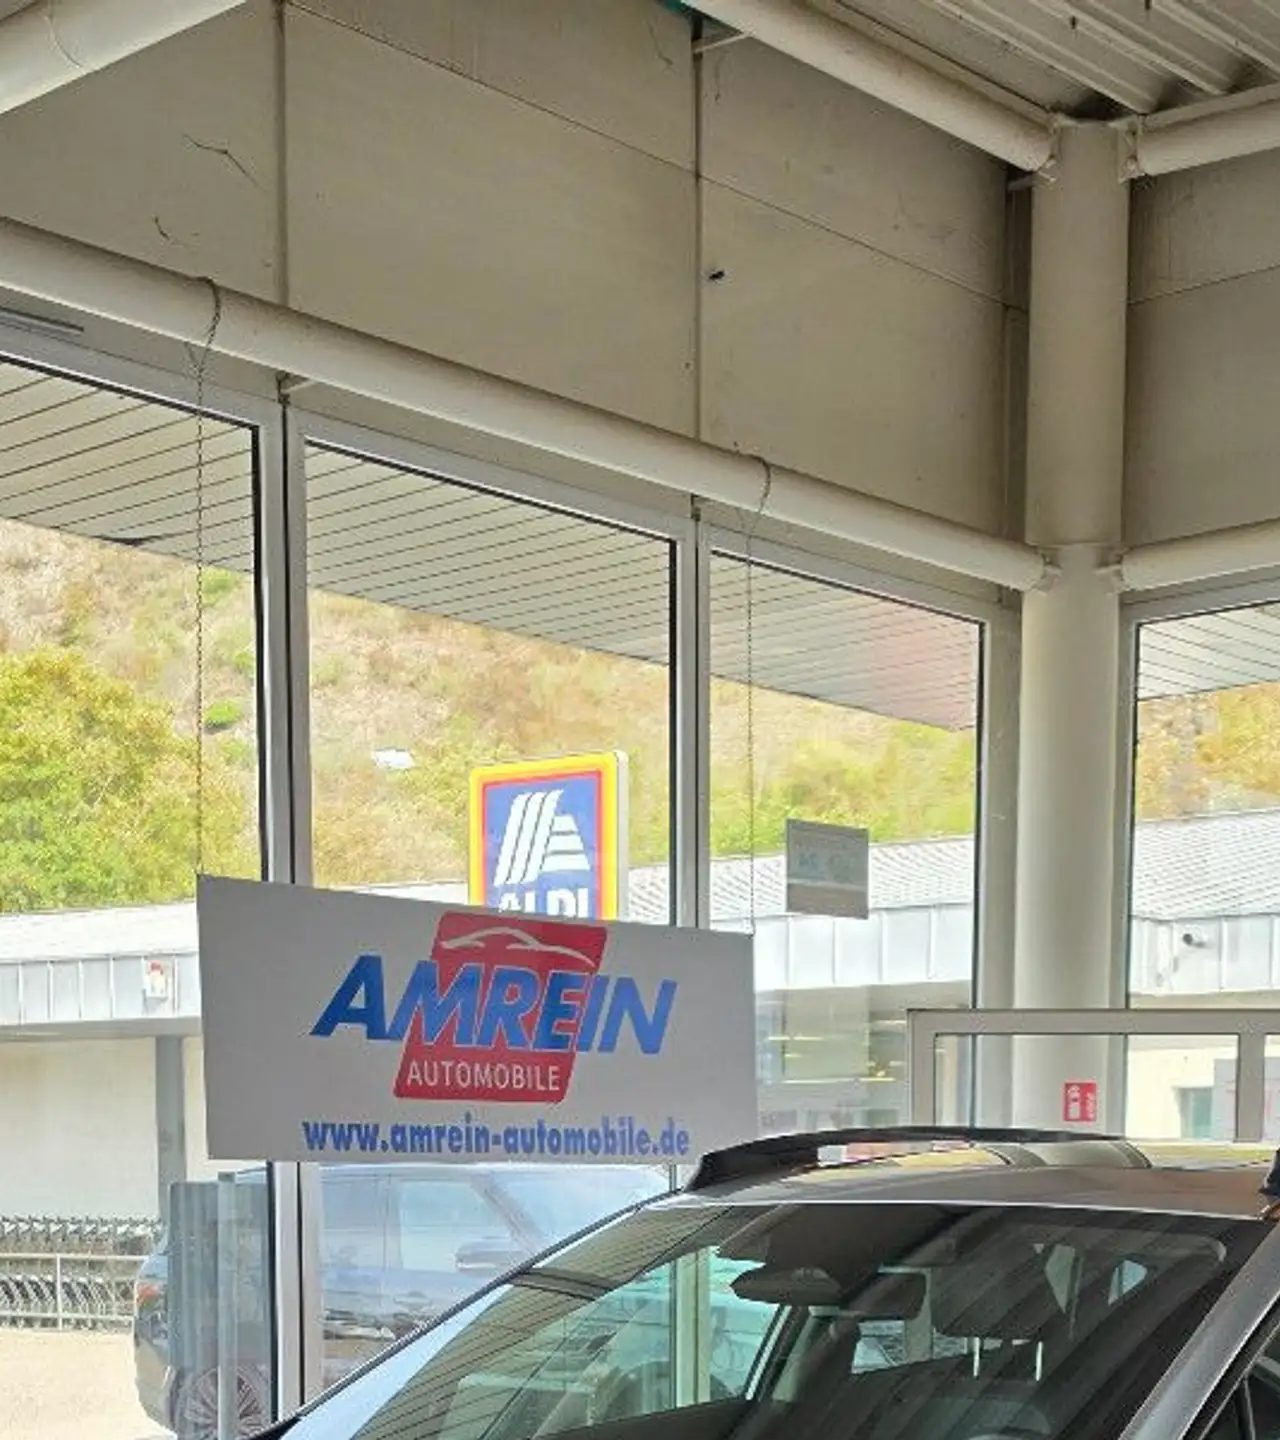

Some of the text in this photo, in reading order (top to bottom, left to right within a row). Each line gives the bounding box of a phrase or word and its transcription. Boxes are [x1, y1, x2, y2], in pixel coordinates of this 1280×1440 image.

[309, 953, 678, 1055] AMREIN
[406, 1059, 561, 1092] AUTOMOBILE
[301, 1111, 691, 1157] www.amrein-automobile.de
